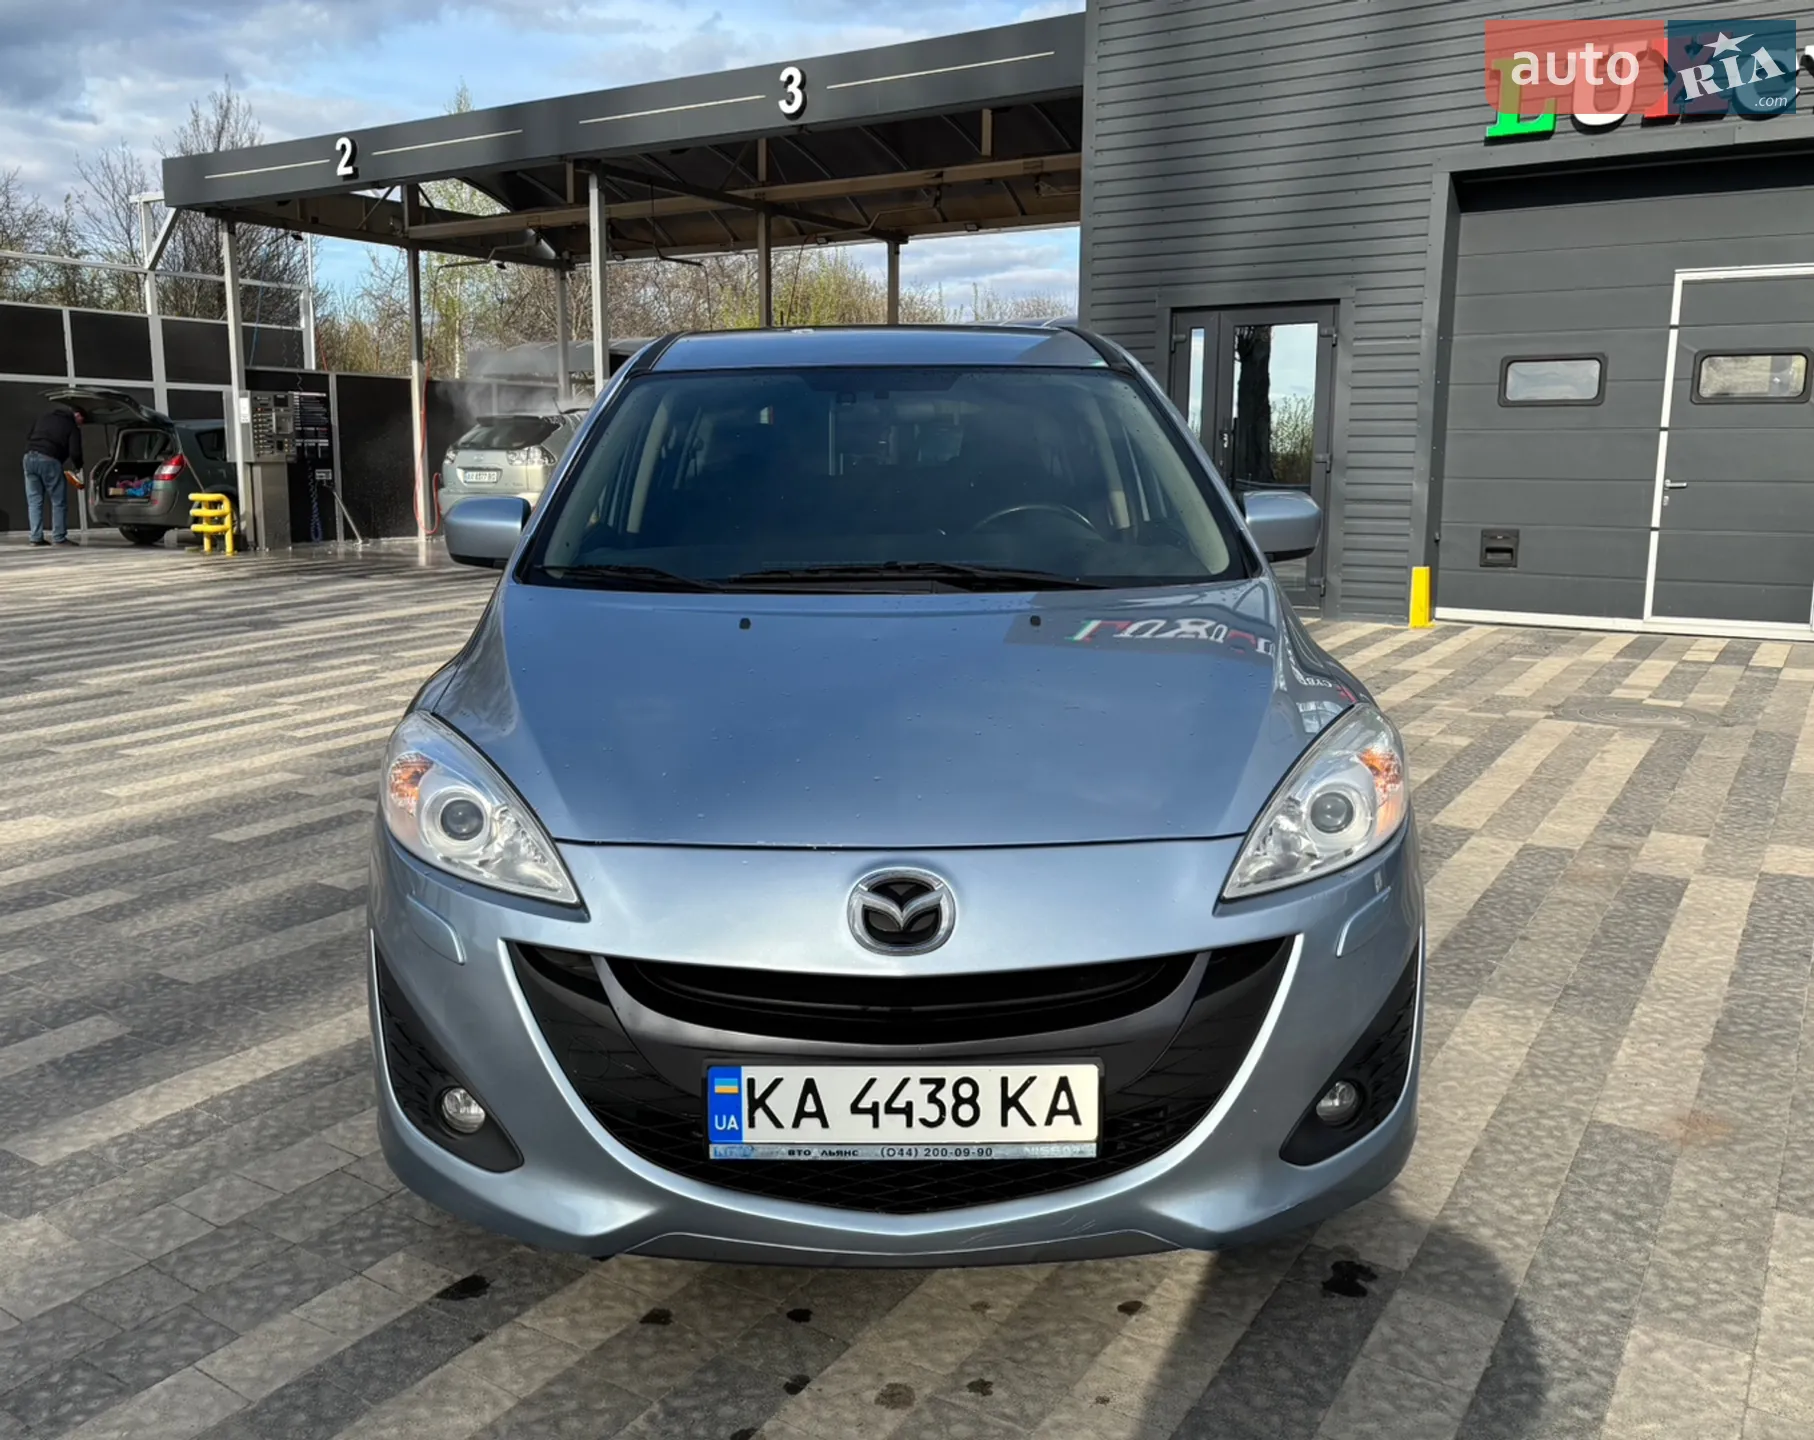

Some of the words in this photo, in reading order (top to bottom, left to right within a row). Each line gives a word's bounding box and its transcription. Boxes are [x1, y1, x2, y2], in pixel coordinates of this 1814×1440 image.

[778, 66, 804, 115] 3
[334, 137, 354, 176] 2
[746, 1076, 829, 1129] KA
[849, 1076, 981, 1129] 4438
[999, 1075, 1082, 1127] KA
[714, 1115, 739, 1131] UA
[923, 1146, 993, 1158] 200-09-90
